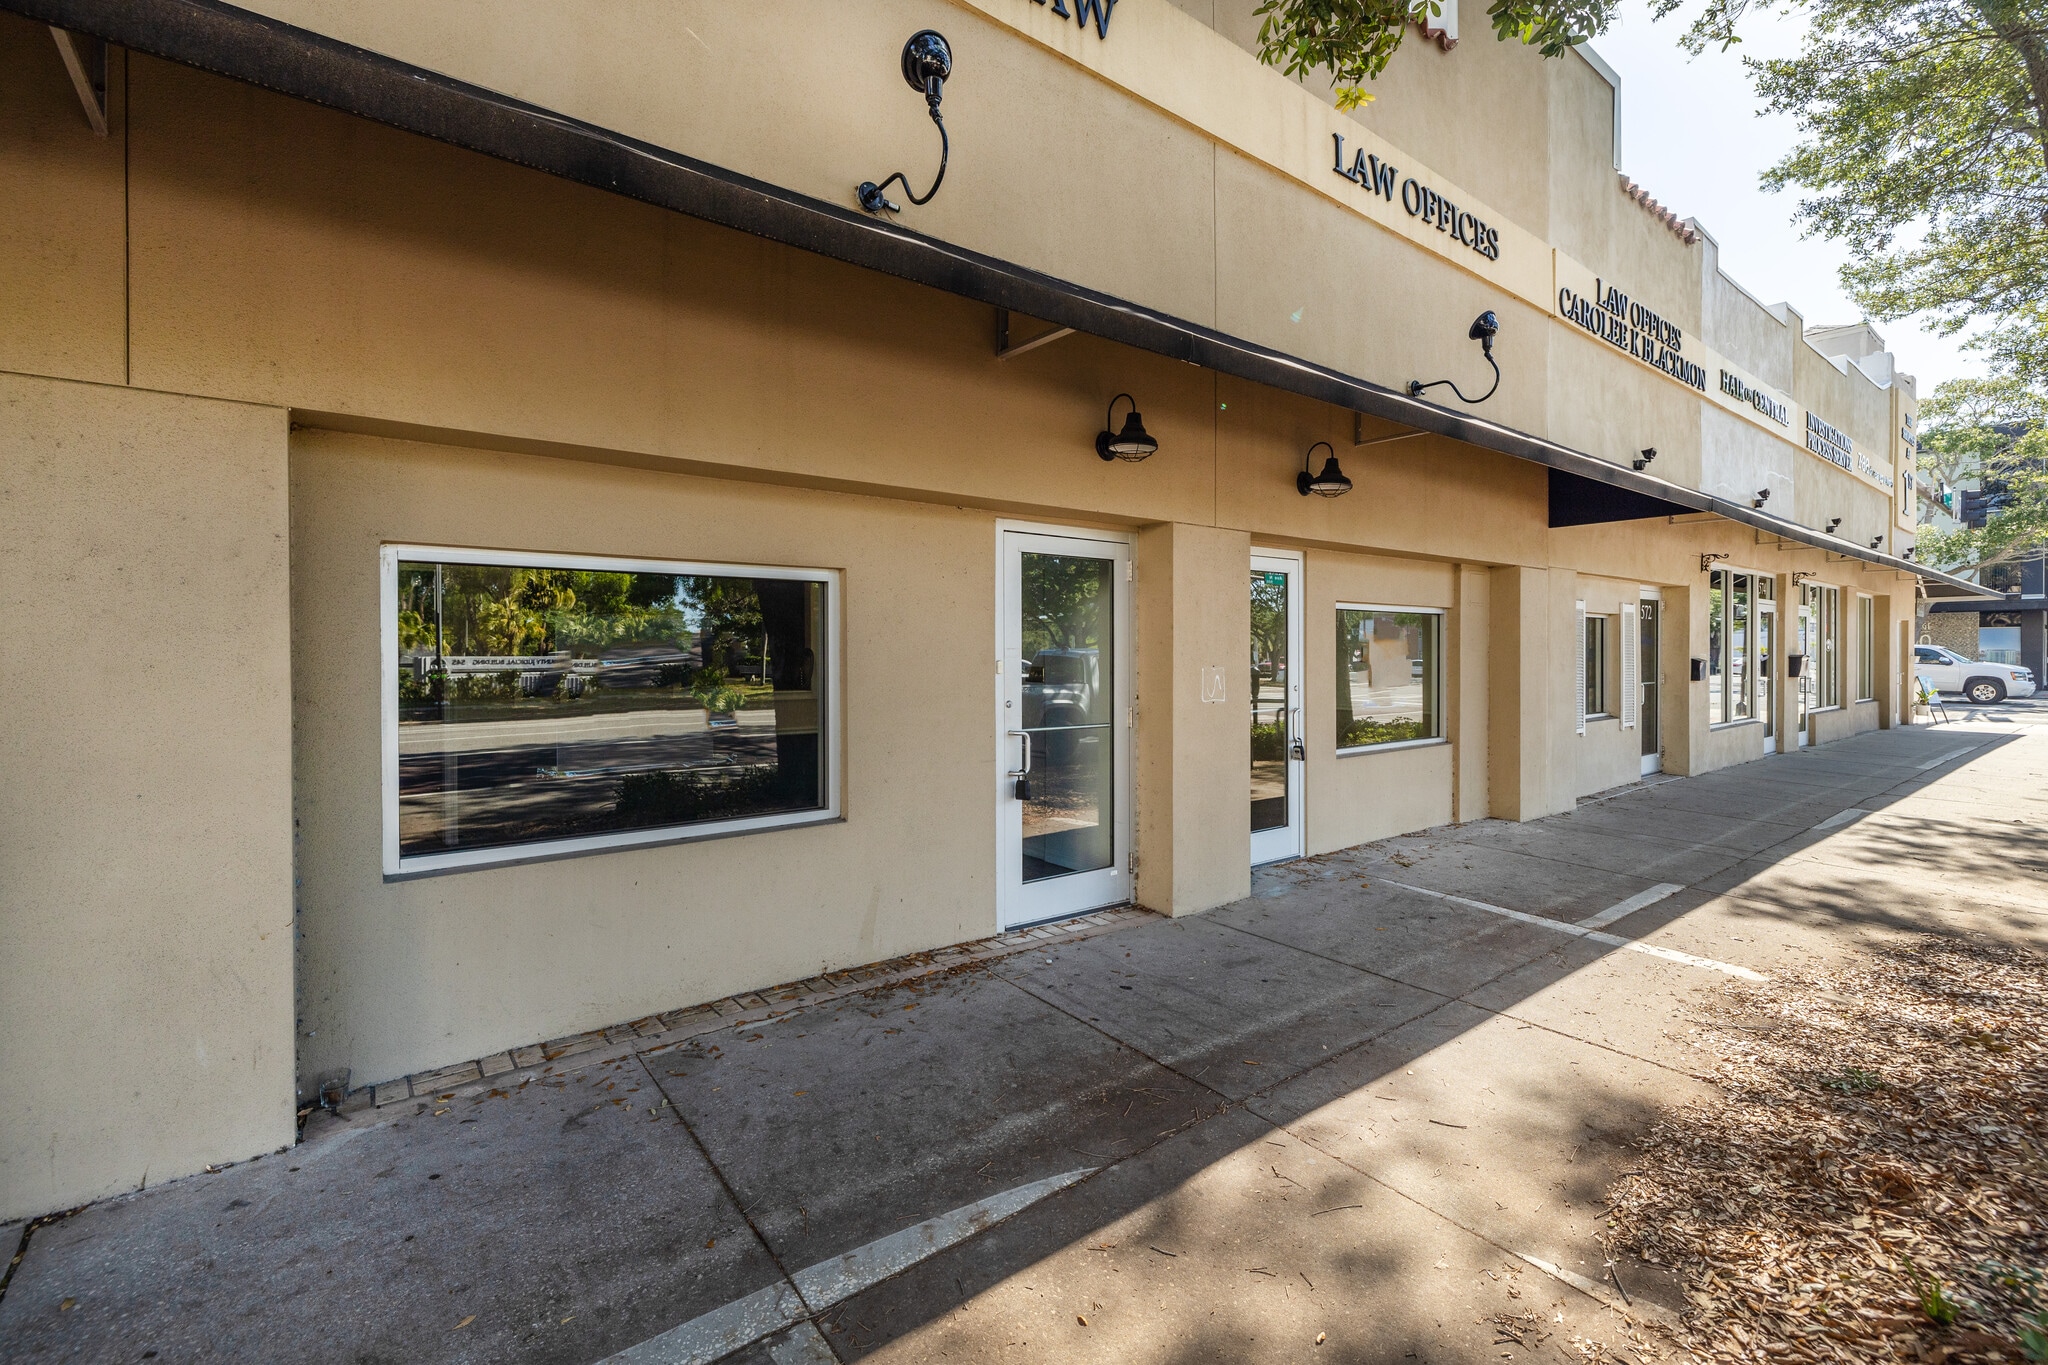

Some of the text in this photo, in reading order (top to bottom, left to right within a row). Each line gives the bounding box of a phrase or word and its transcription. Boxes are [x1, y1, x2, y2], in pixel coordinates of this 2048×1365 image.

[1332, 132, 1500, 261] LAW OFFICES
[1559, 287, 1706, 392] CAROLEE K BLACKMON
[1596, 278, 1682, 352] LAW OFFICES
[1719, 369, 1745, 402] HAIR
[1752, 389, 1790, 428] CENTRAL
[1640, 604, 1652, 620] 572
